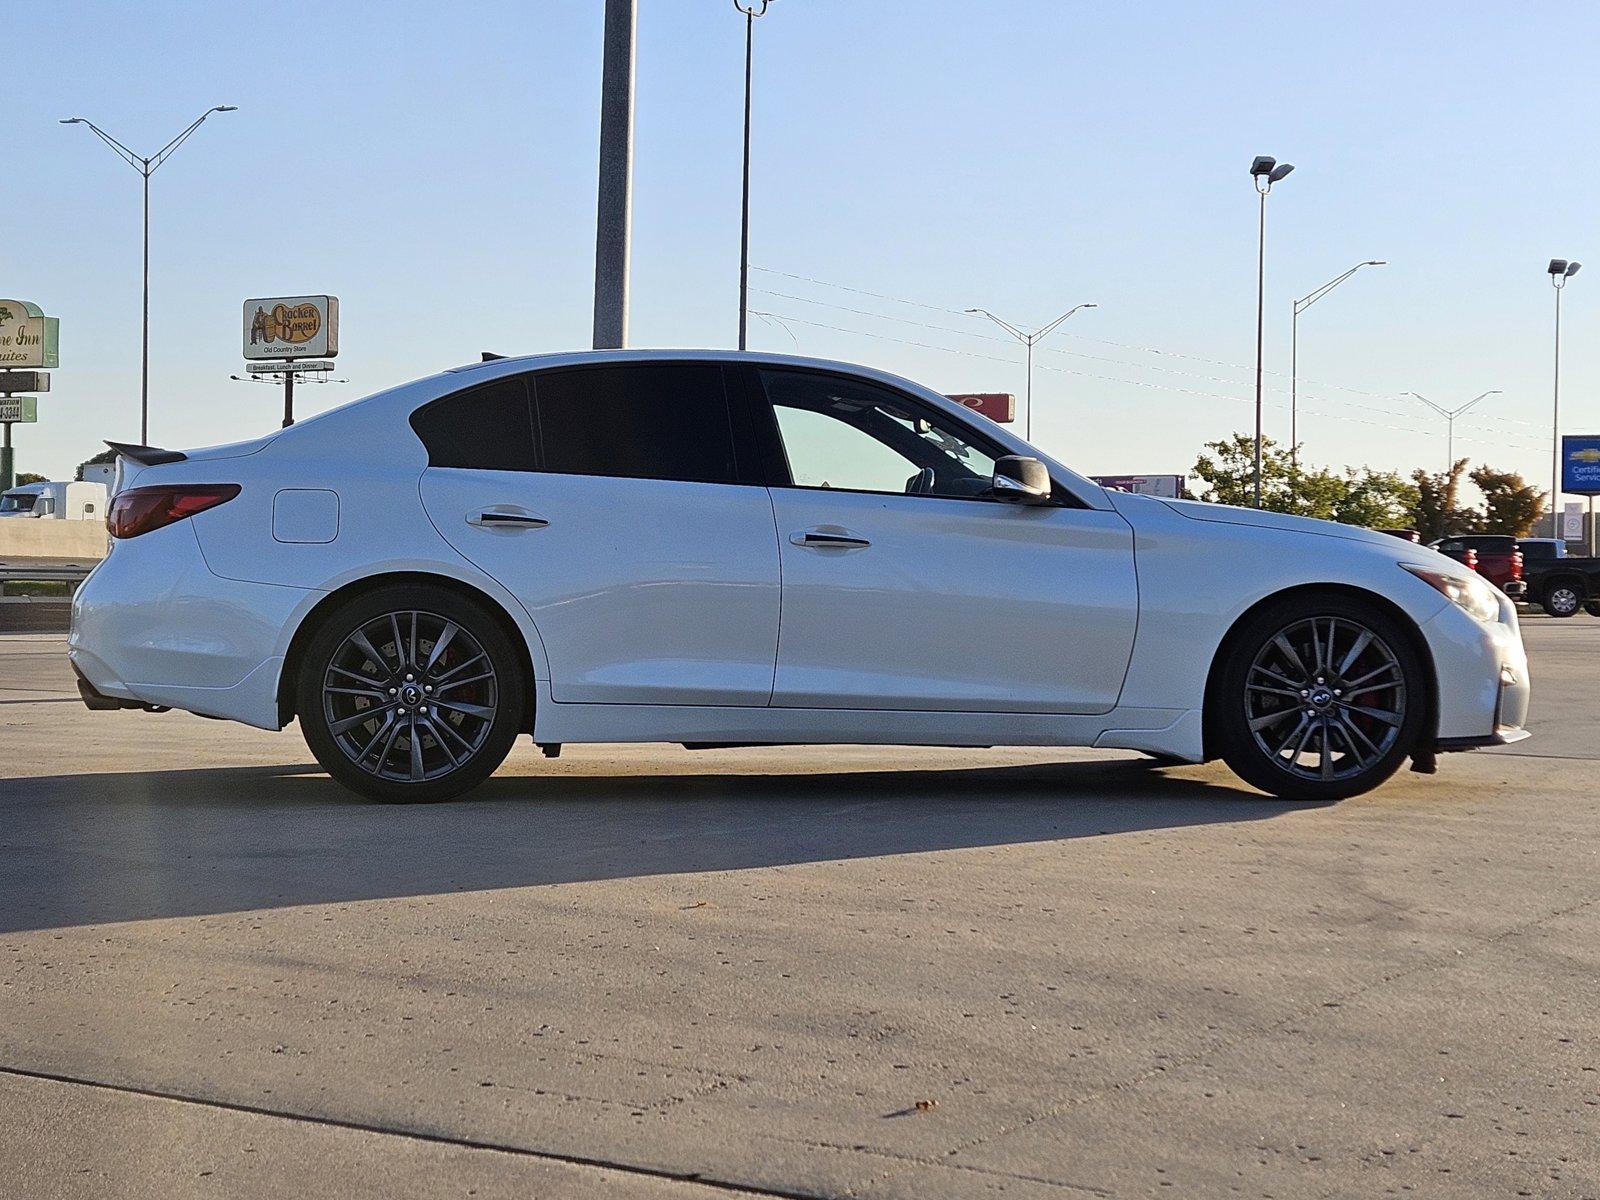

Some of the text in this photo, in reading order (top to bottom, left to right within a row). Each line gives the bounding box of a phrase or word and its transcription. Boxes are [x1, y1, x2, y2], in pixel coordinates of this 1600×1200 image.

[274, 305, 314, 326] Cracker
[0, 325, 39, 346] re Inn
[282, 319, 317, 340] Barrel
